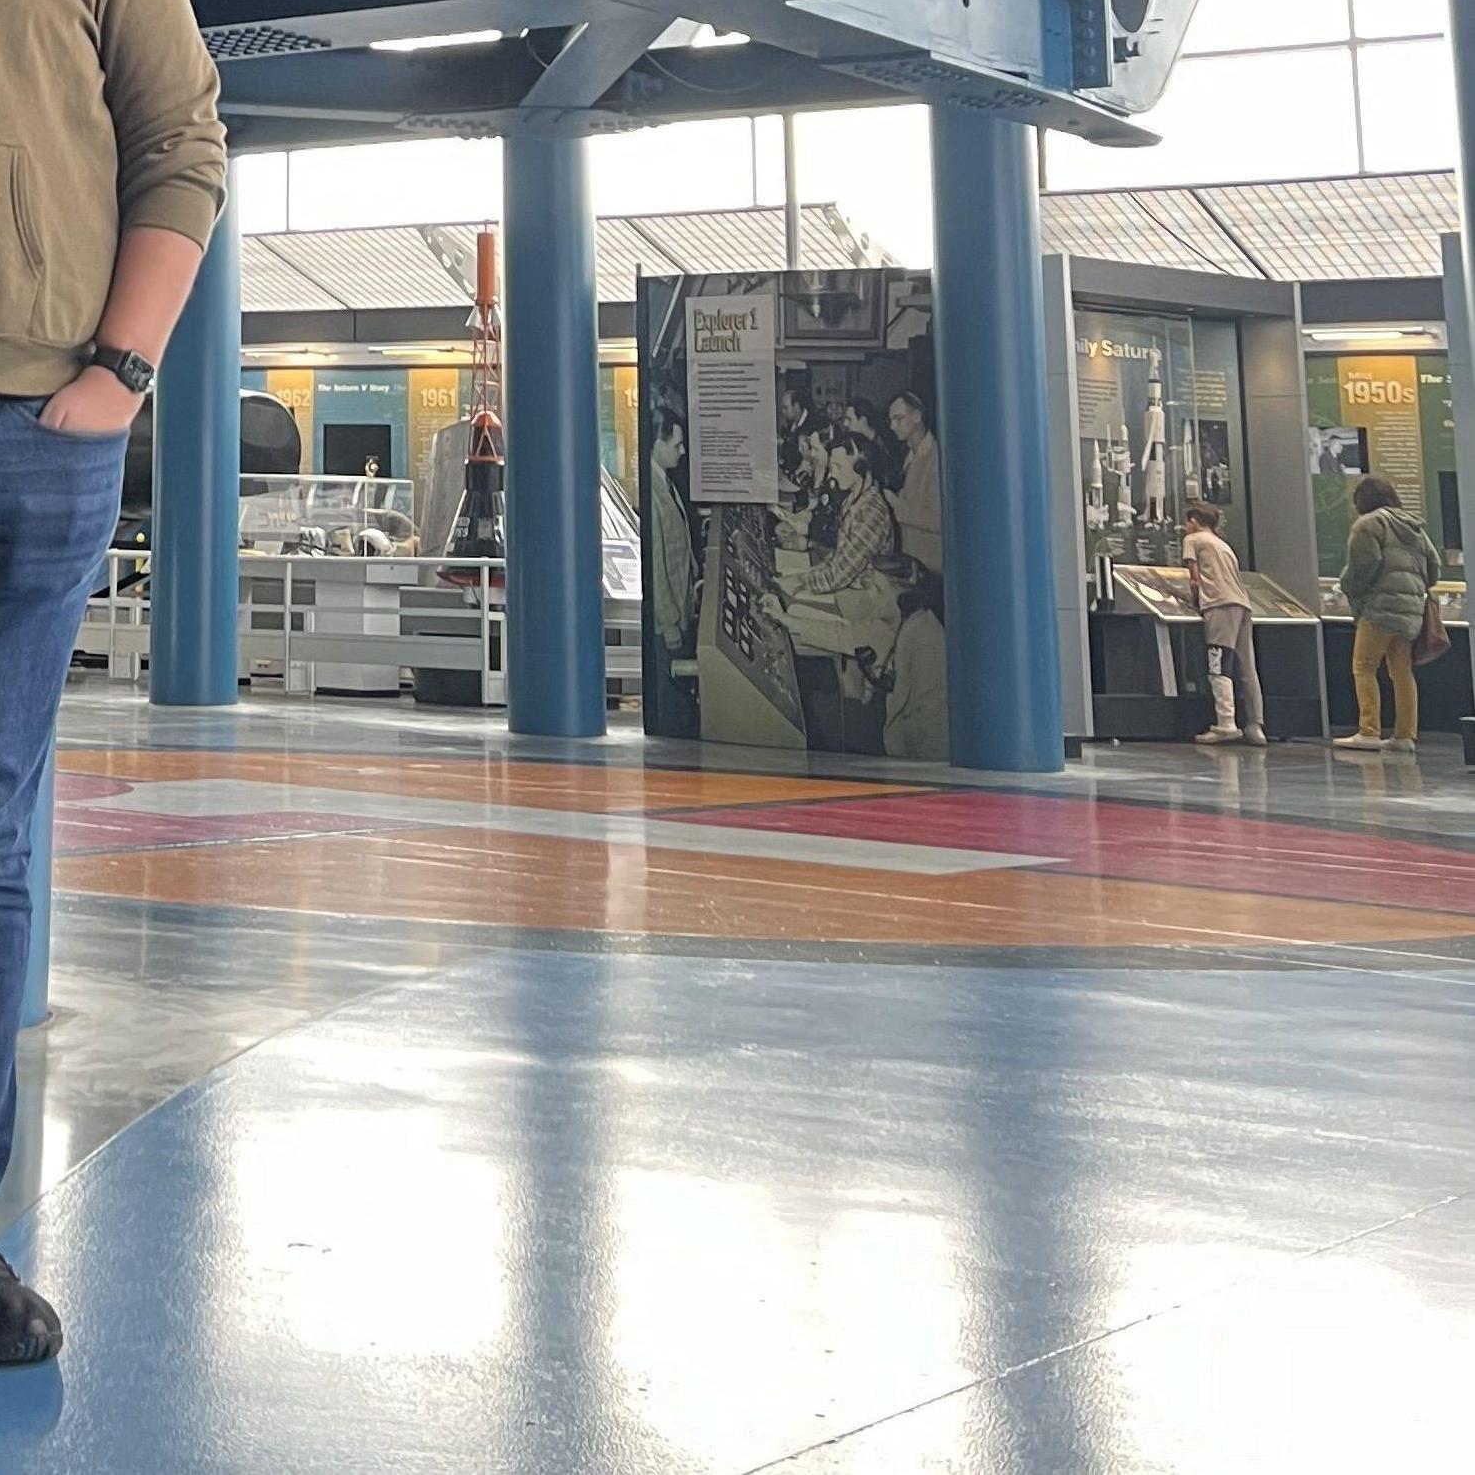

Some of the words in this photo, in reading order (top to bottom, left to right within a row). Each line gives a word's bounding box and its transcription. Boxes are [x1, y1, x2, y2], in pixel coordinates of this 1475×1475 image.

[693, 308, 747, 336] Explorer
[749, 306, 758, 331] 1
[694, 331, 741, 353] Launch
[1075, 337, 1098, 358] ily
[421, 388, 457, 408] 1961
[1343, 381, 1416, 405] 1950s
